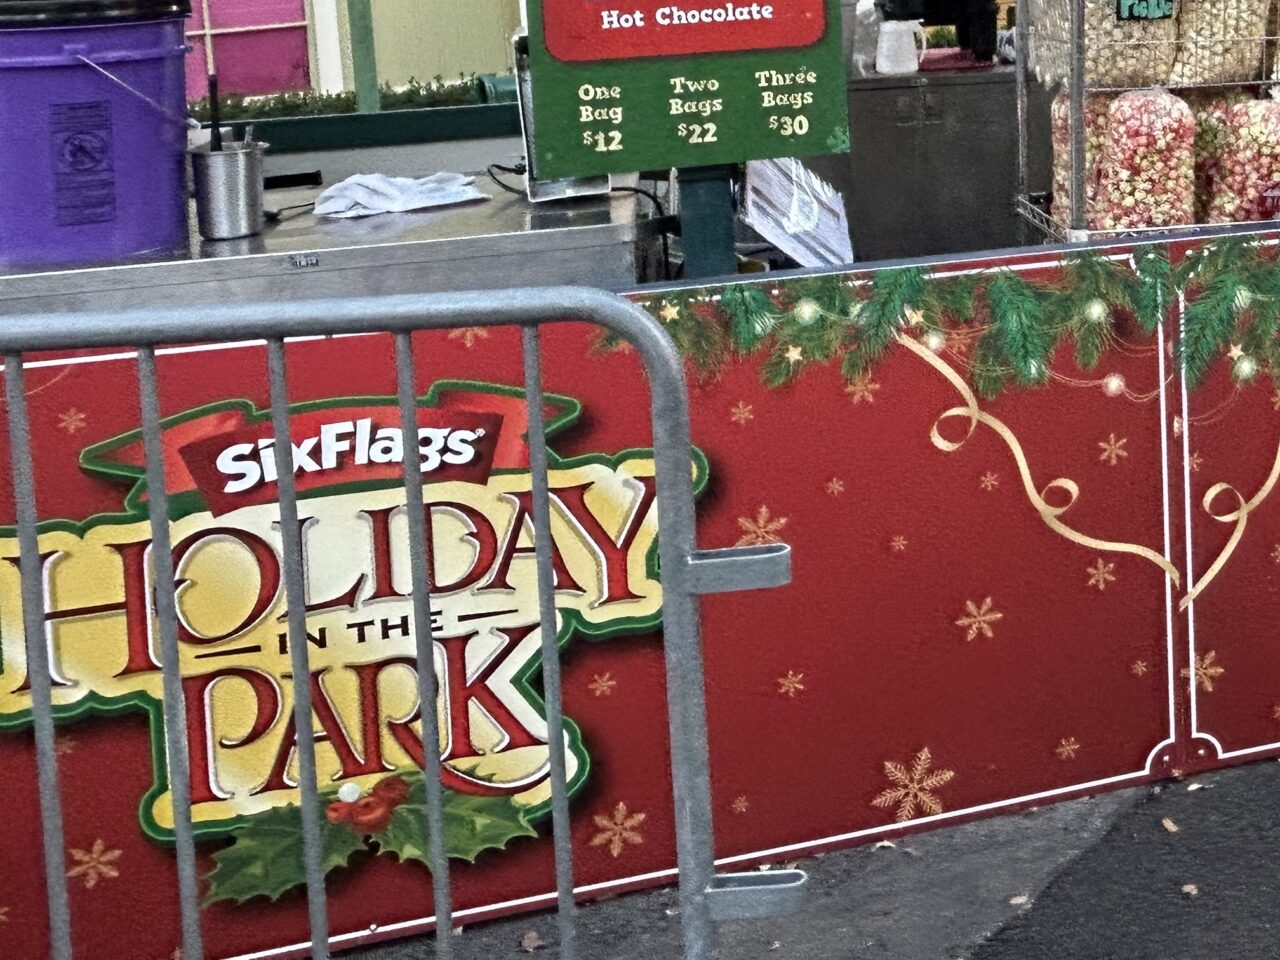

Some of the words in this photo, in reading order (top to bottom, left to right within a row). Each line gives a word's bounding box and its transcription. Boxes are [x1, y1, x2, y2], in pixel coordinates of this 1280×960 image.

[601, 10, 644, 29] Hot
[656, 3, 773, 26] Chocolate
[670, 78, 719, 93] Two
[755, 70, 817, 87] Three
[578, 85, 621, 101] One
[762, 92, 813, 108] Bags
[579, 106, 622, 122] Bag
[669, 99, 722, 114] Bags
[678, 123, 718, 144] $22
[768, 115, 809, 136] $30
[582, 131, 623, 152] $12
[0, 476, 659, 695] HOLIDAY
[279, 626, 327, 656] IN
[346, 609, 445, 643] THE
[183, 625, 554, 806] PARK
